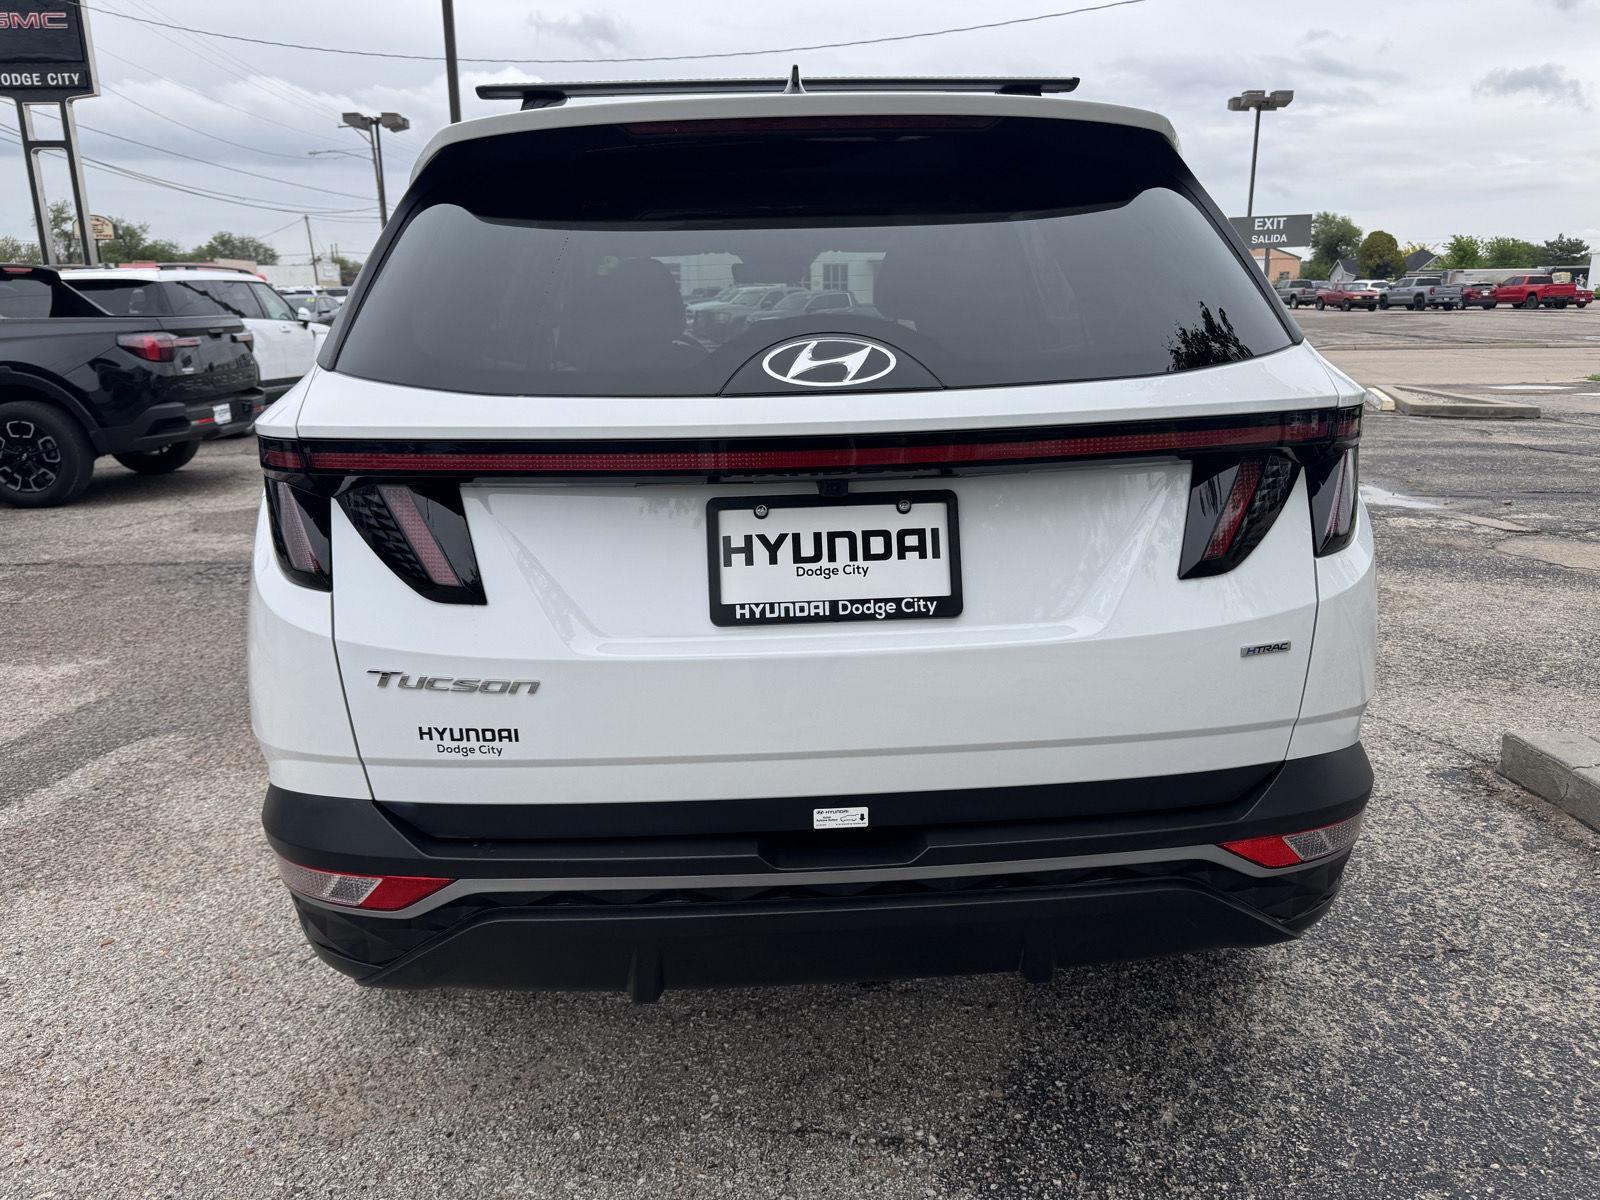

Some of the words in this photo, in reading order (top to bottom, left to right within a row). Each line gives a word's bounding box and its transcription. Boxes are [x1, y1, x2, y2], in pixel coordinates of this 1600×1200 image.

[0, 72, 42, 86] ODGE
[47, 72, 80, 86] CITY
[1254, 217, 1287, 230] EXIT
[1251, 233, 1287, 244] SALIDA
[722, 527, 941, 567] HYUNDAI
[796, 565, 839, 579] Dodge
[842, 563, 870, 578] City
[735, 601, 830, 620] HYUNDAI
[838, 599, 897, 619] Dodge
[901, 597, 937, 616] City
[1246, 642, 1288, 654] HTRAC
[418, 726, 520, 743] HYUNDAI
[436, 744, 476, 757] Dodge
[478, 744, 503, 757] City
